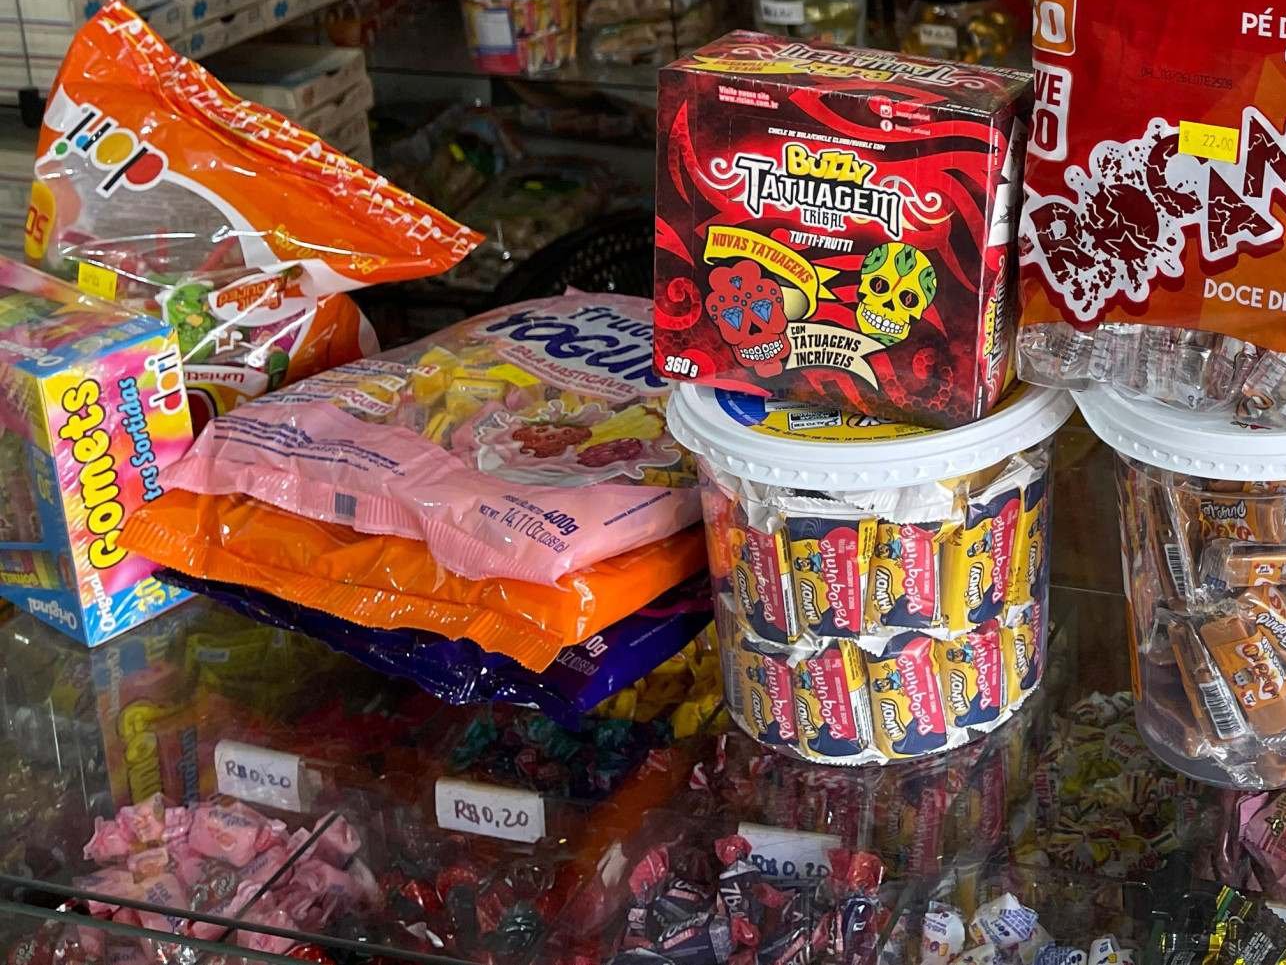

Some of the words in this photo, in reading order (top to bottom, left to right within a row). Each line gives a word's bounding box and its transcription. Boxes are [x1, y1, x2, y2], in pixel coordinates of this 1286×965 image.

[1241, 7, 1273, 37] PÉ
[48, 101, 169, 197] dori
[736, 156, 901, 238] TATUAGEM
[712, 232, 750, 252] NOVAS
[751, 238, 814, 285] TATUAGENS
[789, 230, 854, 253] TUTTI-FRUTTI
[1203, 277, 1263, 310] DOCE
[791, 325, 806, 335] COM
[792, 335, 862, 353] TATUAGENS
[794, 348, 855, 368] INCRÍVEIS
[145, 343, 184, 416] dori
[117, 376, 155, 470] Sortidas
[59, 377, 129, 571] Gomets
[543, 509, 579, 536] 400g
[90, 572, 118, 633] Original
[801, 581, 820, 623] MINDY
[872, 568, 894, 614] MINDY
[966, 563, 985, 612] MINDY
[27, 597, 78, 631] Original
[582, 636, 608, 658] 0g
[947, 670, 971, 717] MINDY
[881, 699, 906, 741] MINDY
